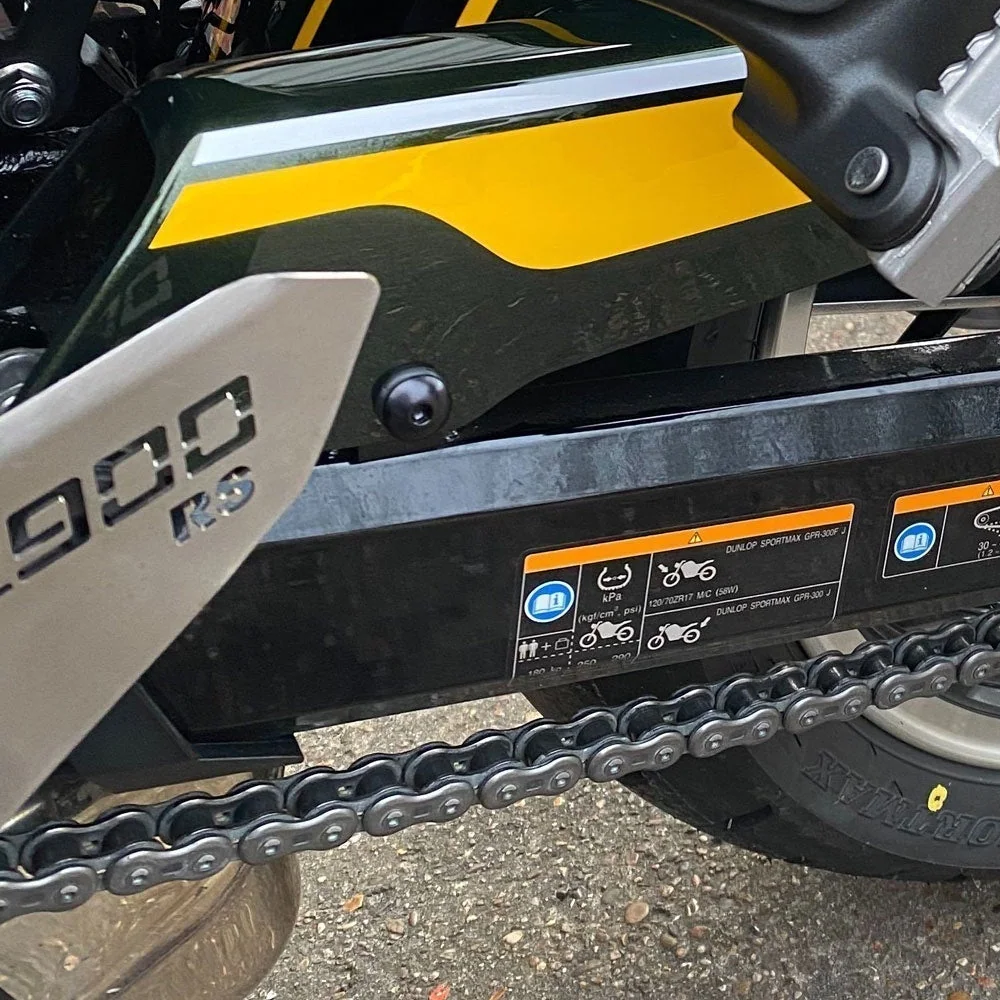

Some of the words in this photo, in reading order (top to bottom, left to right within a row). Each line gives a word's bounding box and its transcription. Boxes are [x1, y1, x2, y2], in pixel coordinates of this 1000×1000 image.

[0, 375, 257, 597] 900
[169, 465, 256, 546] RS
[725, 540, 758, 554] DUNLOP
[760, 533, 802, 548] SPORTMAX
[804, 527, 840, 541] GPR-300F
[977, 540, 990, 551] 30
[602, 591, 622, 603] kPa
[648, 592, 694, 608] 120/70ZR17
[696, 589, 712, 600] M/C
[716, 603, 748, 616] DUNLOP
[750, 595, 791, 609] SPORTMAX
[793, 589, 825, 602] GPR-300
[623, 604, 642, 617] psi)
